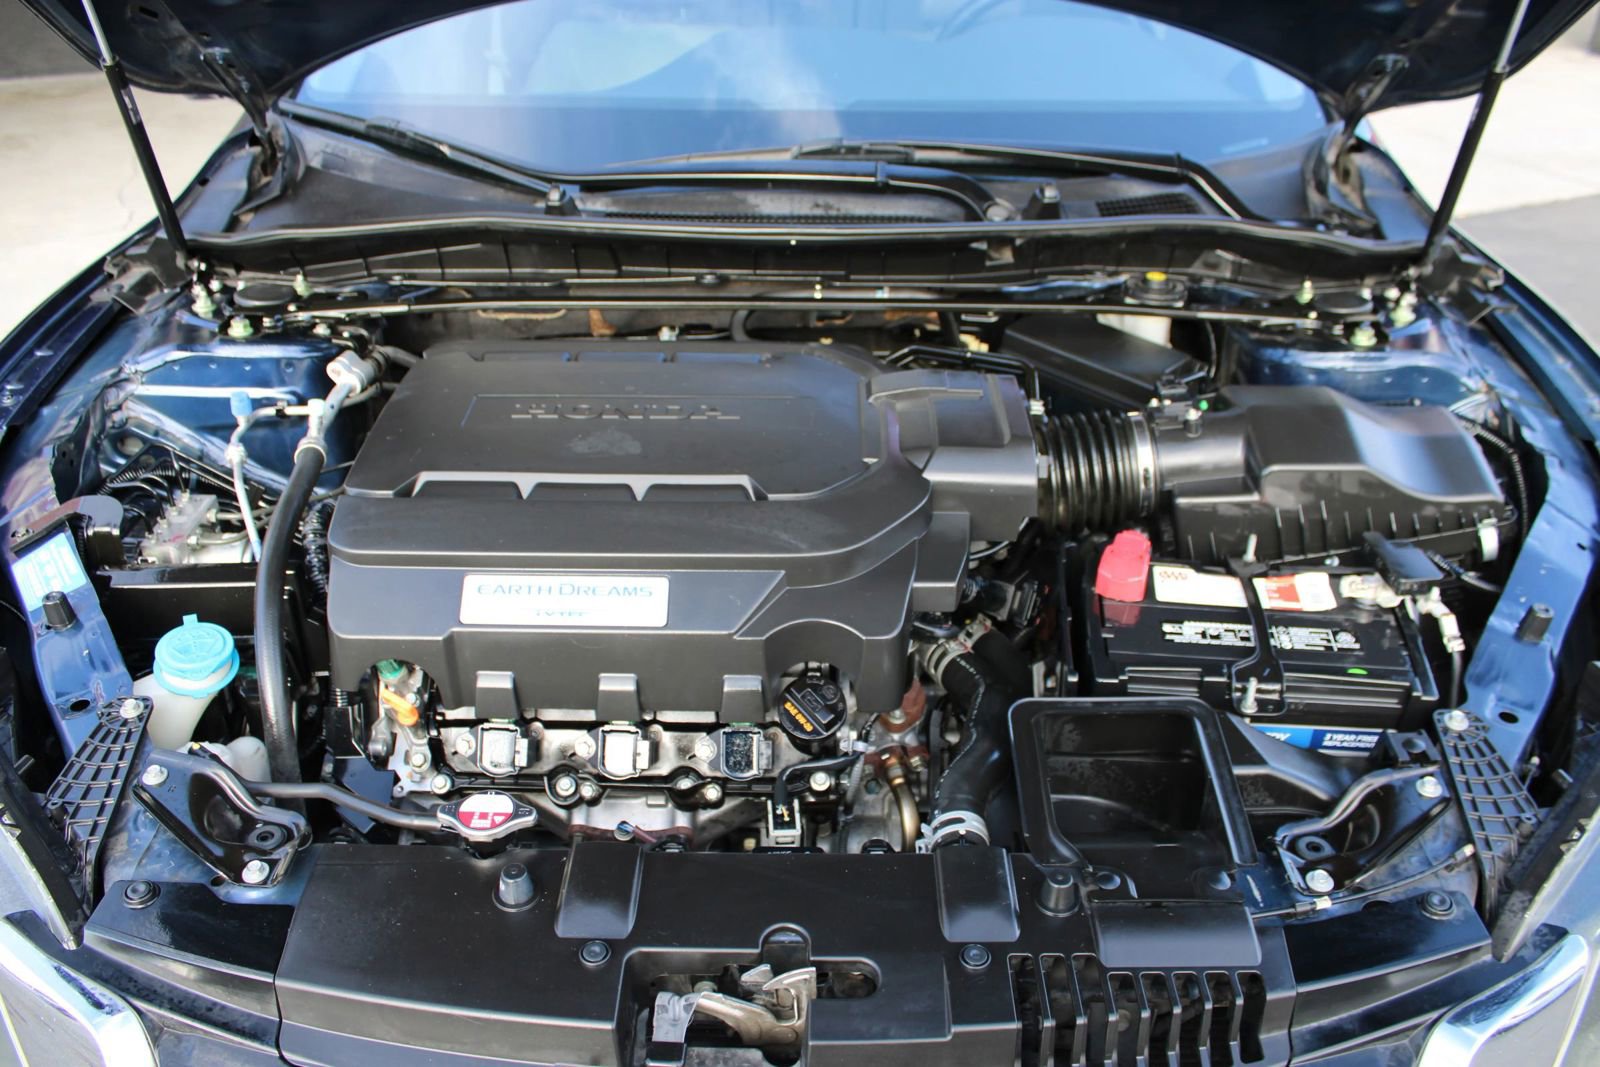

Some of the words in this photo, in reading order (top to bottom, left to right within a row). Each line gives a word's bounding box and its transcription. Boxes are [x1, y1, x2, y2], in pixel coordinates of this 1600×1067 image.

[511, 403, 741, 420] HONDA
[476, 583, 553, 597] EARTH
[558, 582, 653, 598] DREAMS
[1321, 740, 1376, 749] REPLACEMENT
[1331, 733, 1356, 742] YEAR
[1356, 734, 1380, 743] FREE
